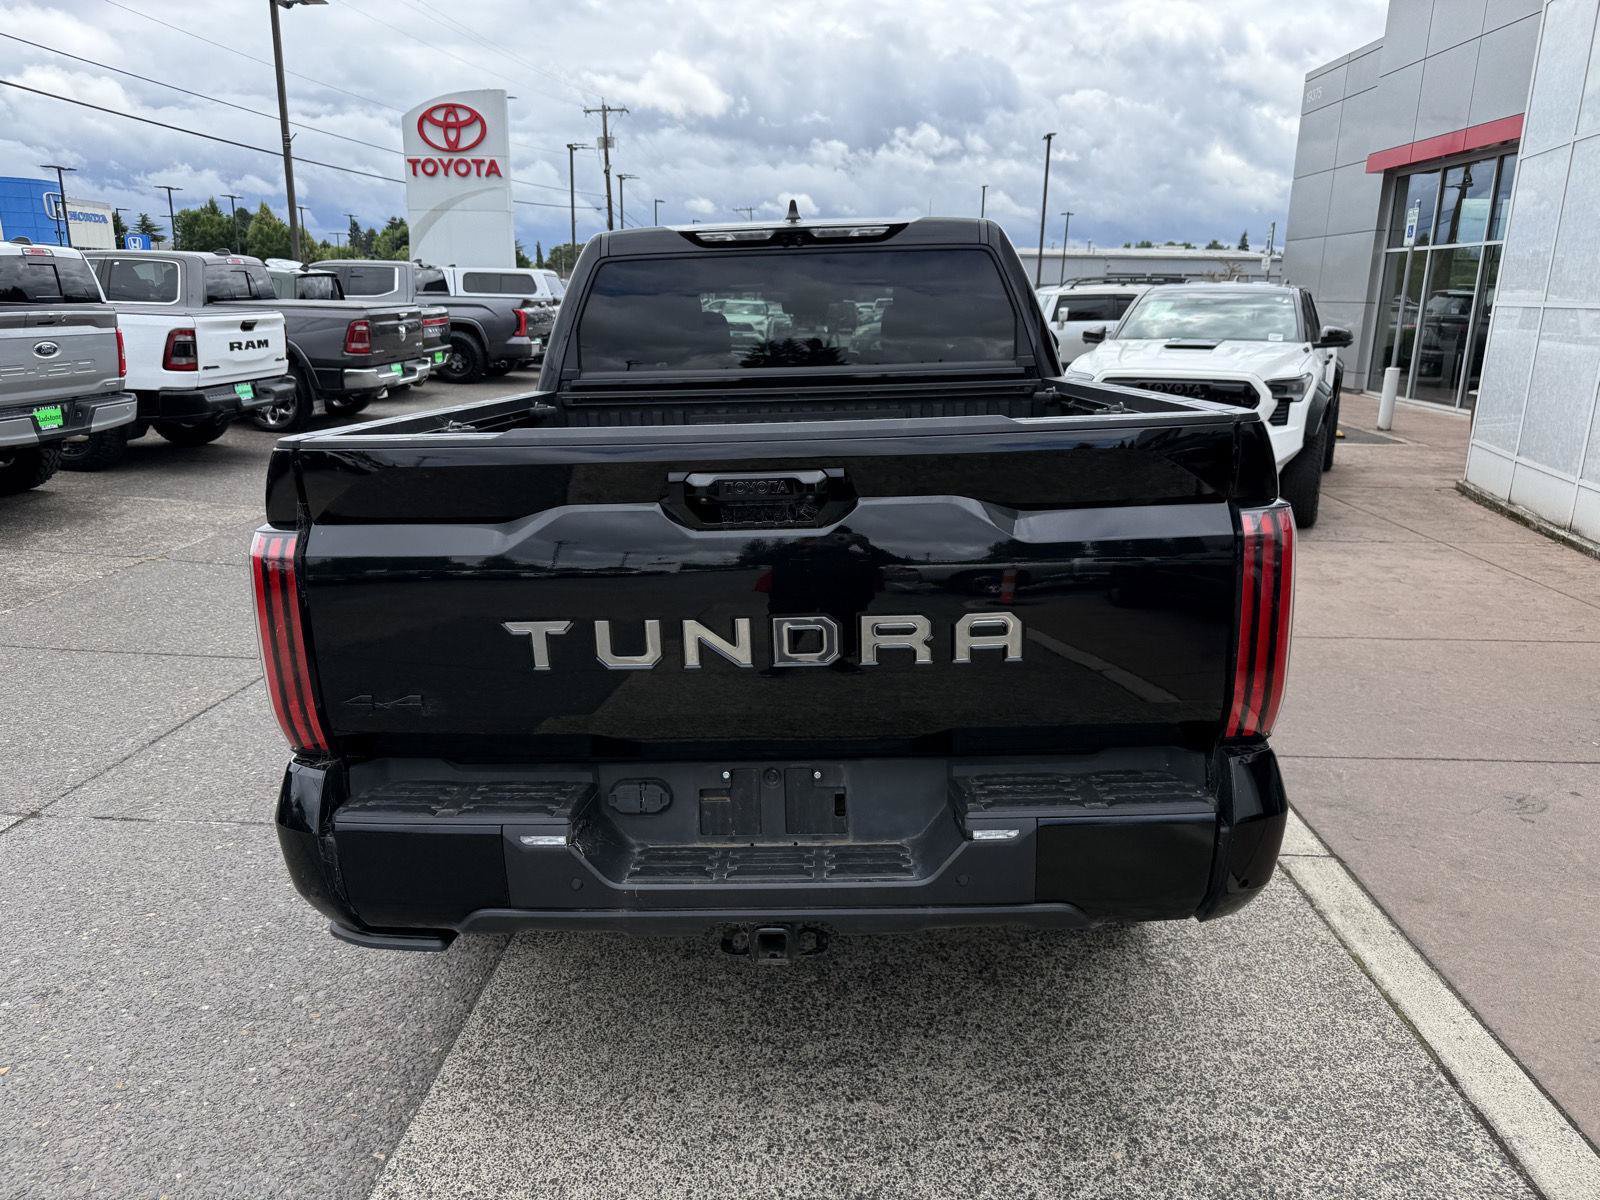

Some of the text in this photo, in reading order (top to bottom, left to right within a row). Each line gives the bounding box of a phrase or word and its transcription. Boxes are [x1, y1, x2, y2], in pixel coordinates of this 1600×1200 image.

[407, 158, 503, 178] TOYOTA
[67, 210, 109, 224] HONDA
[229, 339, 270, 352] RAM
[1144, 384, 1202, 394] TOYOTA
[723, 480, 790, 495] TOYOTA
[502, 611, 1024, 671] TUNDRA
